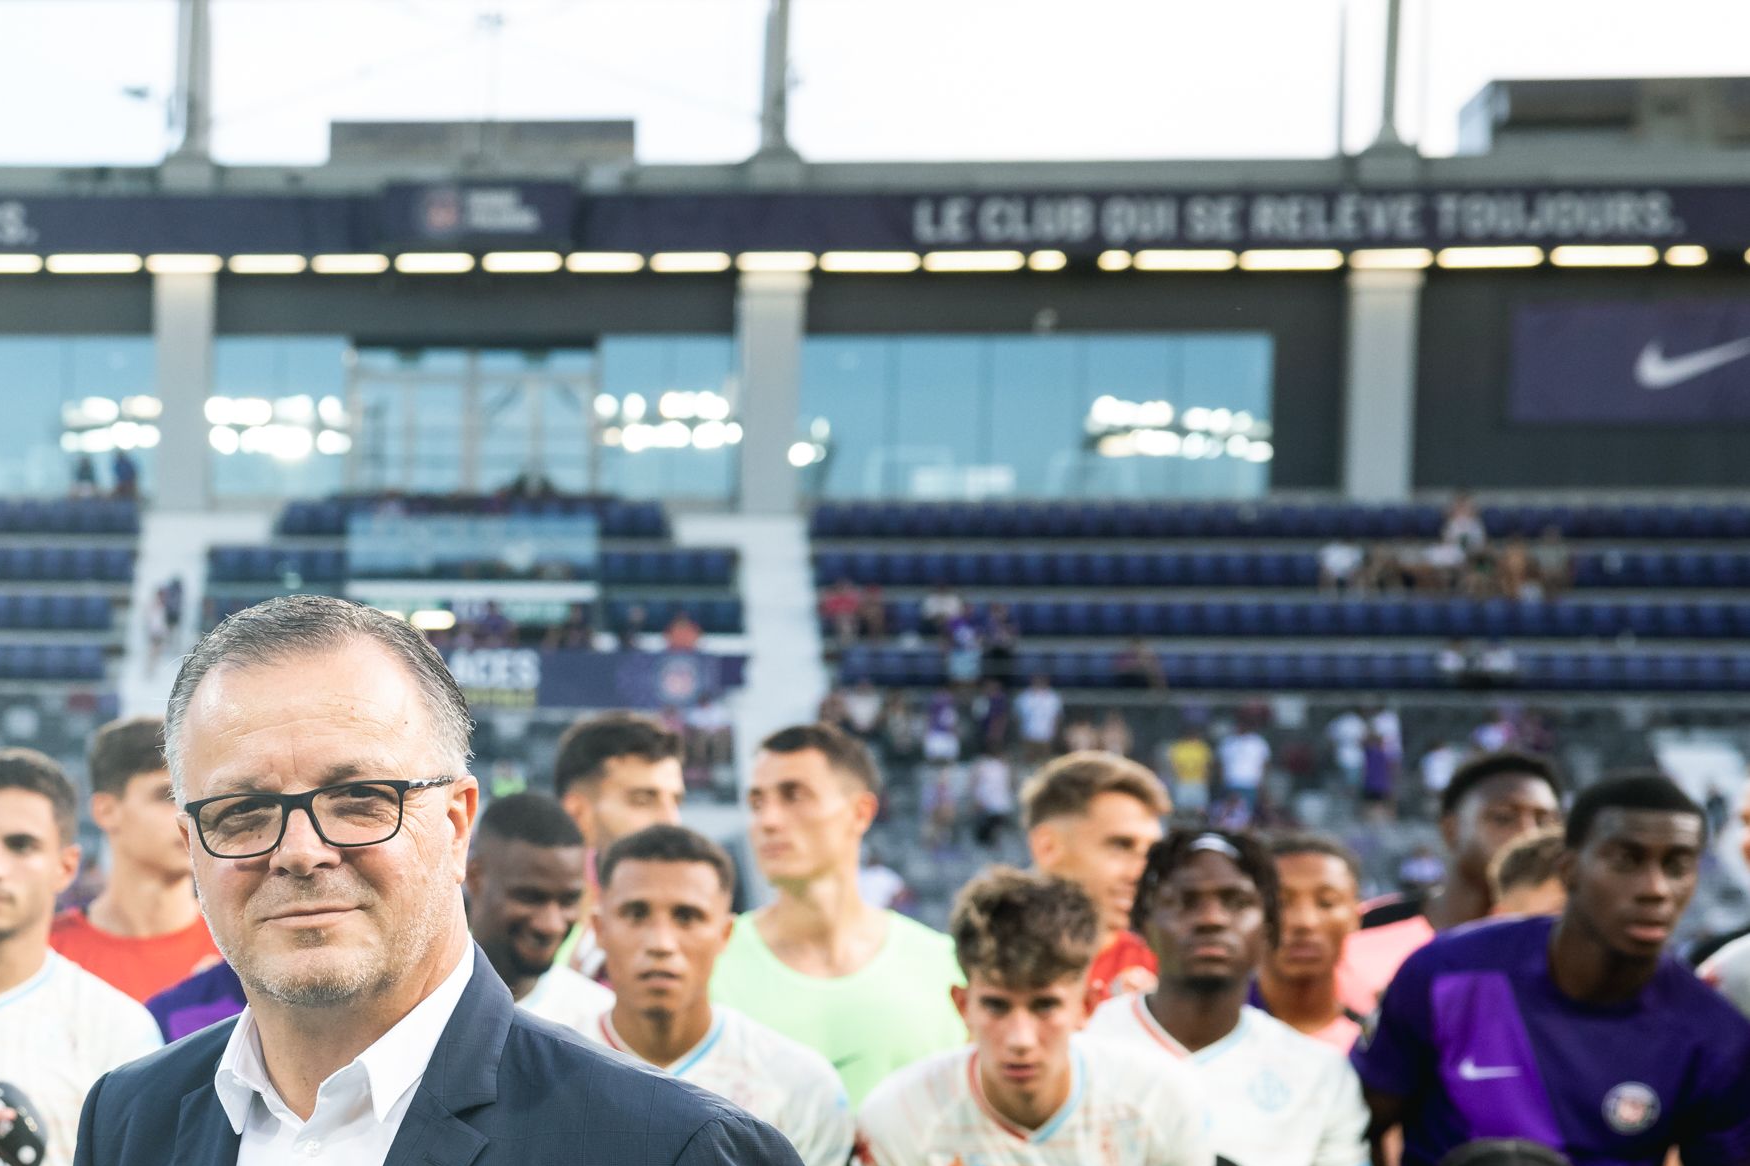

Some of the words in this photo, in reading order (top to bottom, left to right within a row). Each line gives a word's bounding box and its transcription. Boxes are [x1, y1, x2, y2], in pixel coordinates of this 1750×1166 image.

[912, 198, 971, 243] LE
[978, 198, 1095, 243] CLUB
[1102, 197, 1178, 245] QUI
[1184, 197, 1243, 242] SE
